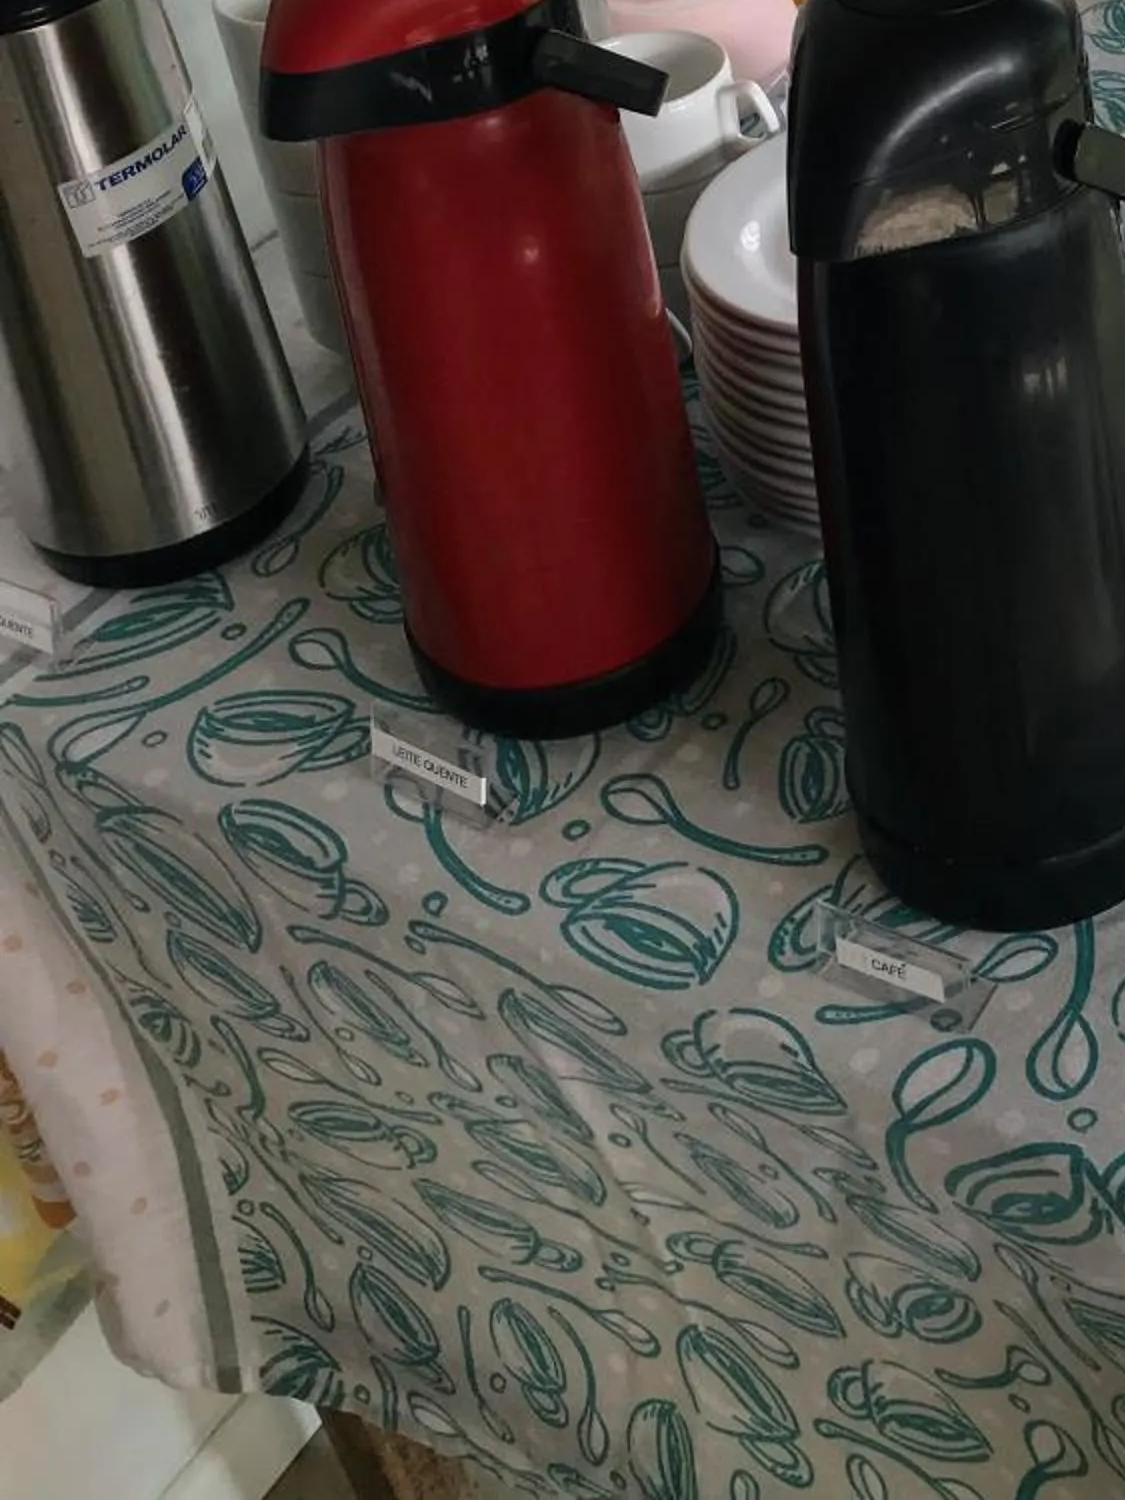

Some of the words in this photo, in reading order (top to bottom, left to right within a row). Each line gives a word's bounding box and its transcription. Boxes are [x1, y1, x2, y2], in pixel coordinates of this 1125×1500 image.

[94, 123, 188, 192] TERMOLAR
[423, 759, 470, 790] QUENTE
[871, 957, 907, 982] CAFÉ
